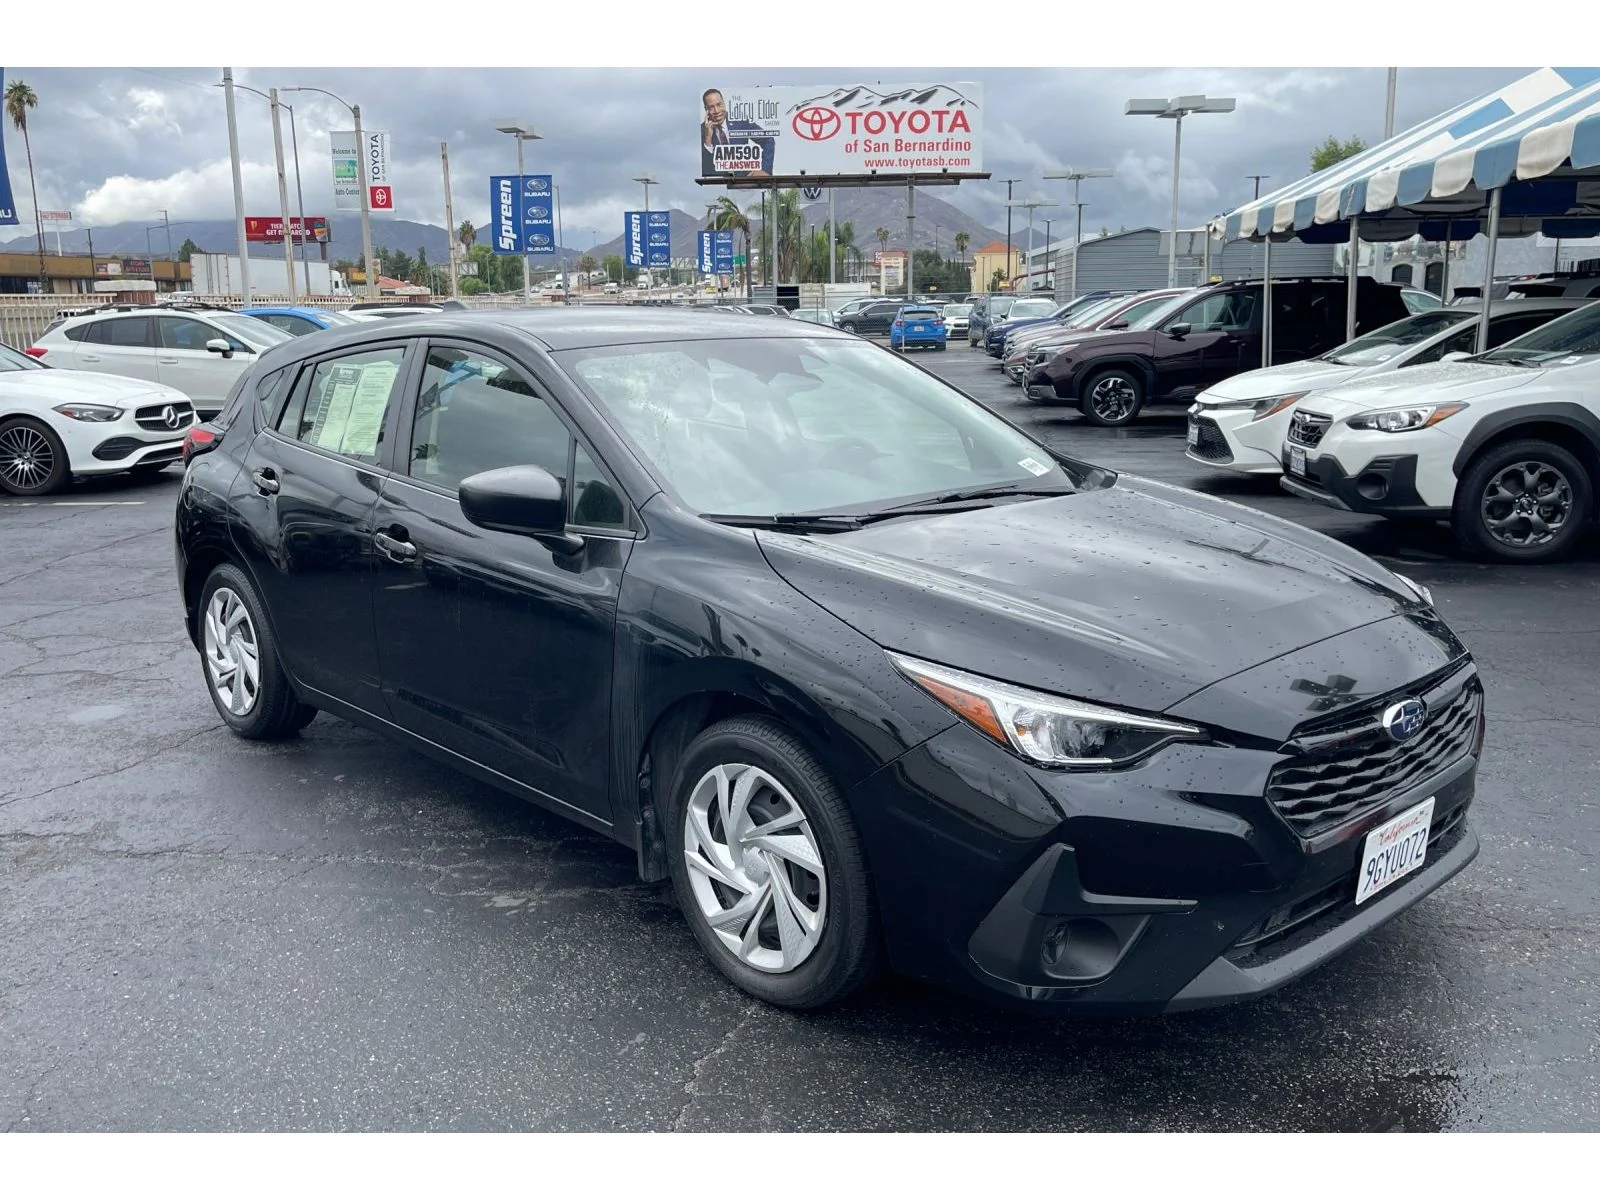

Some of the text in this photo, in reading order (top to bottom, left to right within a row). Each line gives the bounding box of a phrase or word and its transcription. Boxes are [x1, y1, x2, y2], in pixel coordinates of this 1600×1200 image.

[729, 99, 780, 122] Larry Elder
[845, 109, 971, 135] TOYOTA
[371, 133, 380, 182] TOYOTA
[715, 145, 760, 161] AM590
[845, 138, 971, 153] of San Bernardino
[729, 161, 760, 170] ANSWER
[864, 156, 970, 168] www.toyotasb.com
[335, 187, 360, 196] Auto Center
[499, 179, 517, 251] Spreen
[630, 213, 644, 266] Spreen
[701, 232, 713, 273] Spreen
[1363, 827, 1427, 893] 9GYU072
